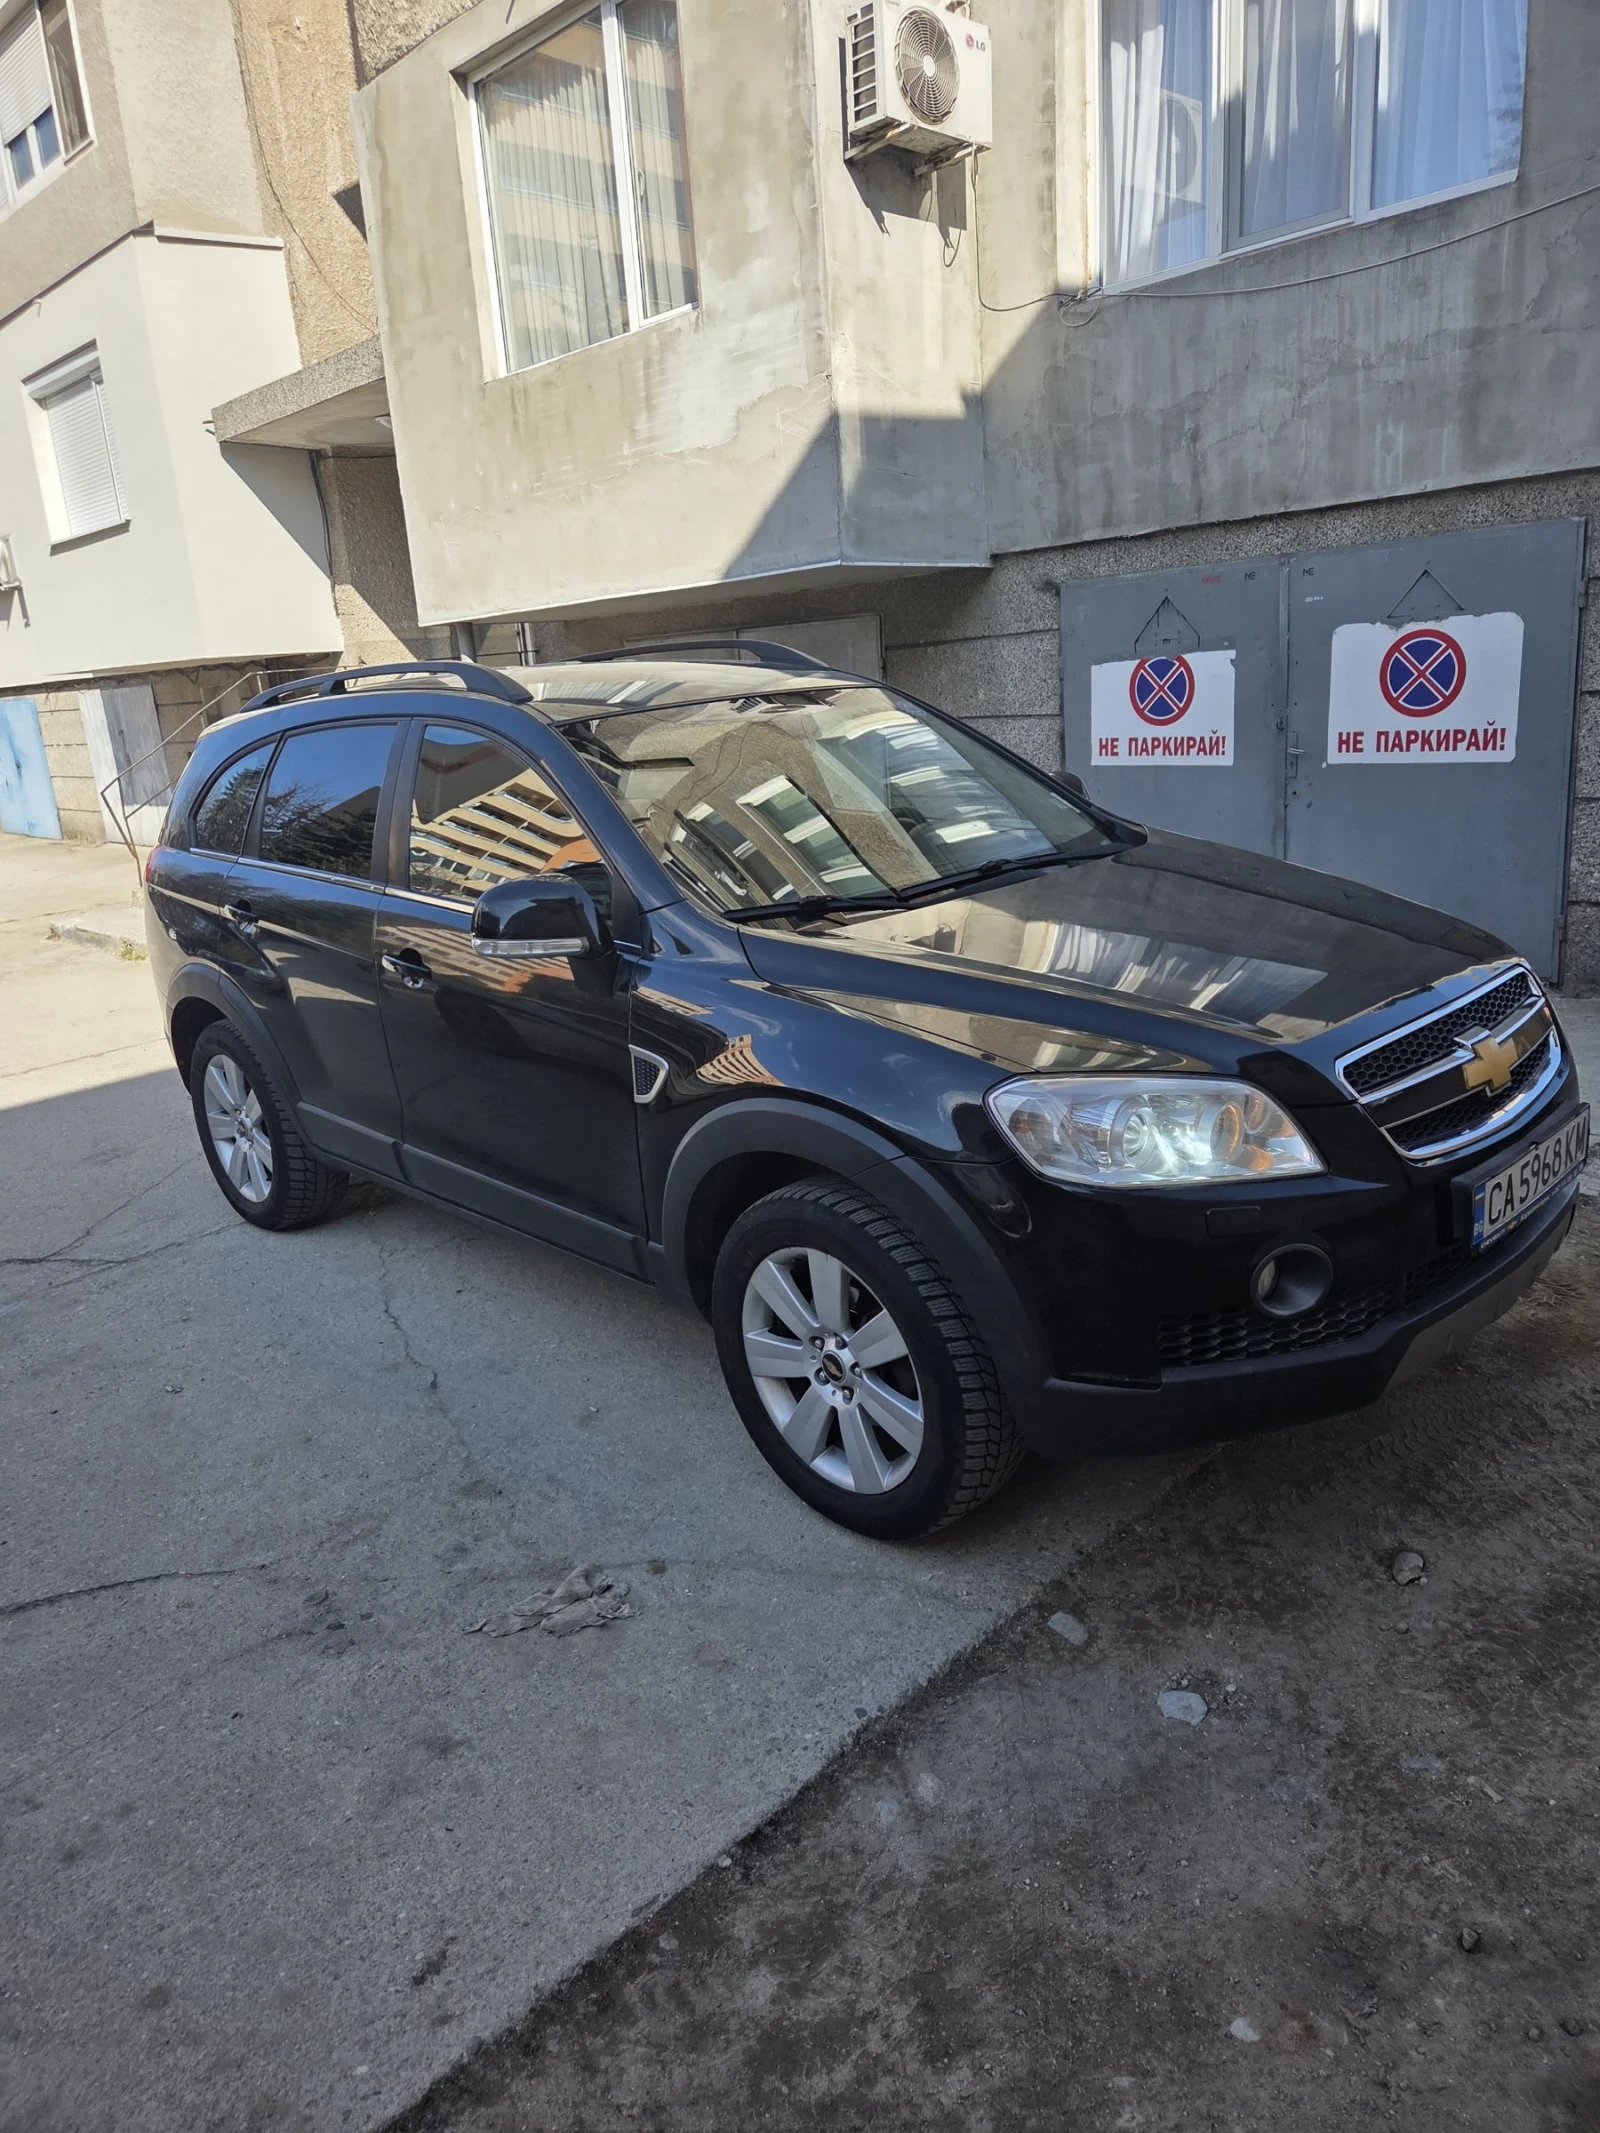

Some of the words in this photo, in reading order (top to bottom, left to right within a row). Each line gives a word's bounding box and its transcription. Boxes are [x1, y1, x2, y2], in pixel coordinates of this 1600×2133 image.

[976, 40, 986, 51] LG
[1098, 737, 1120, 757] НЕ
[1127, 729, 1227, 757] ПАРКИРАЙ!
[1337, 731, 1365, 754] НЕ
[1375, 720, 1507, 753] ПАРКИРАЙ!
[1473, 1220, 1484, 1237] BG
